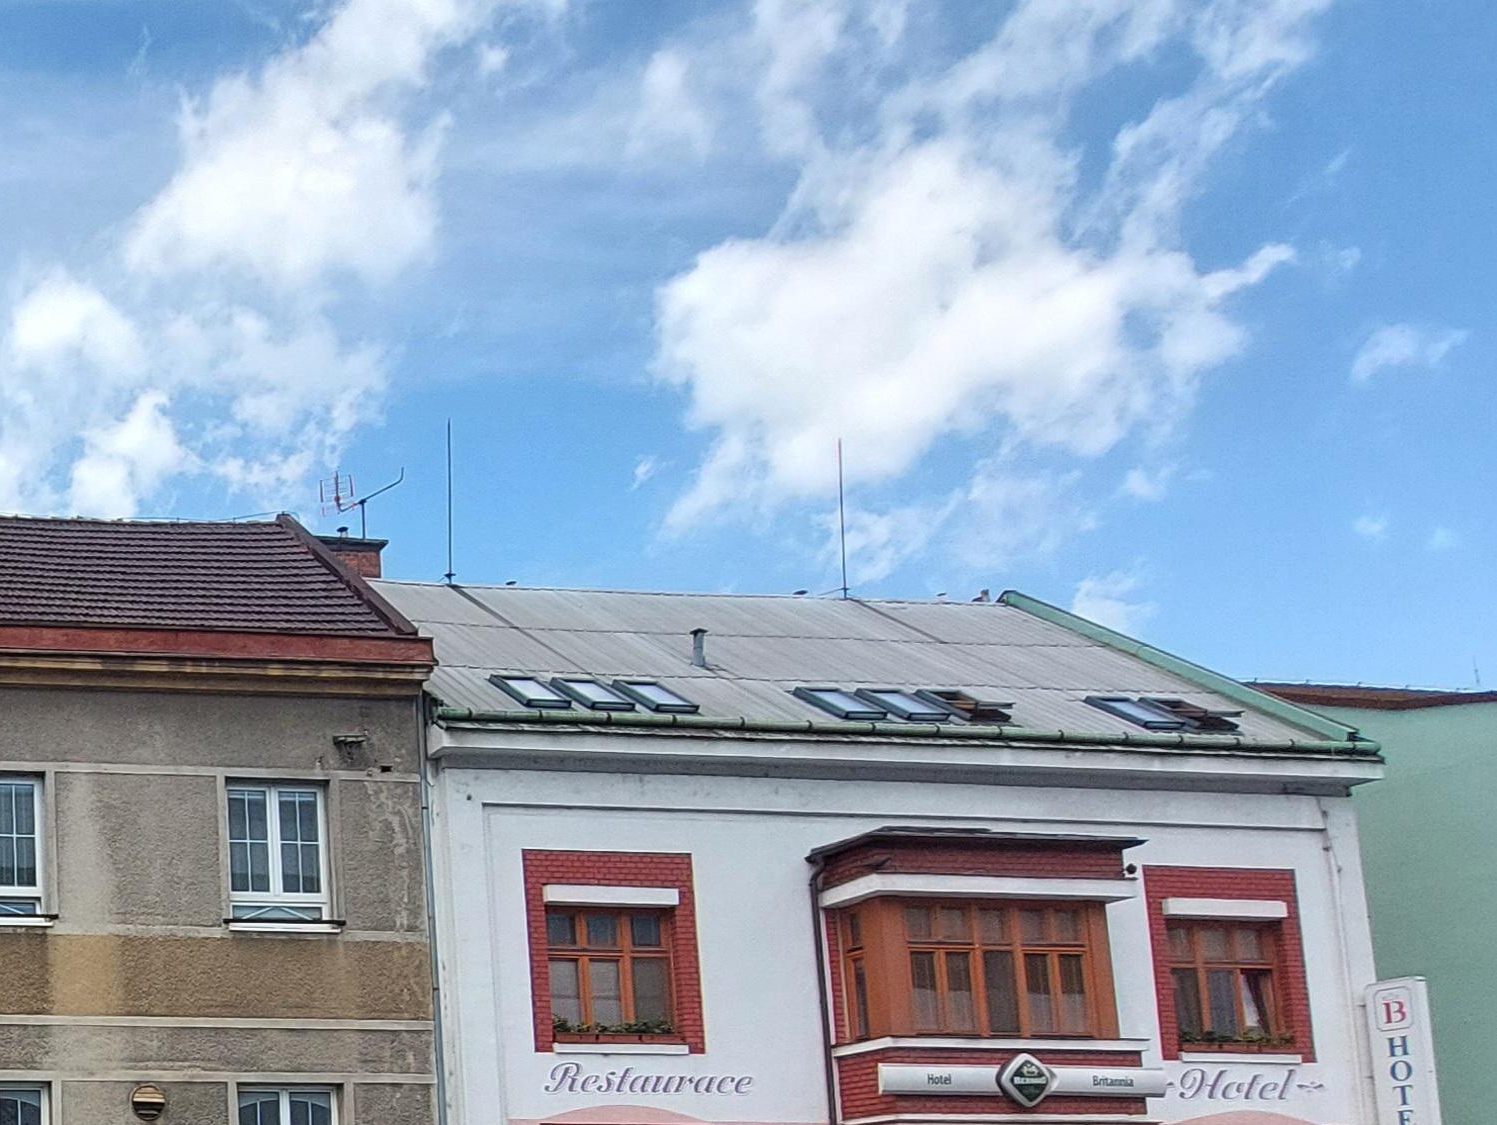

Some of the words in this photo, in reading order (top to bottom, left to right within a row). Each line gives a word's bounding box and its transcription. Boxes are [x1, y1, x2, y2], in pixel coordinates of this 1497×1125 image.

[1382, 1000, 1407, 1025] B
[544, 1061, 754, 1095] Restaurace
[927, 1073, 952, 1085] Hotel
[1092, 1075, 1134, 1087] Britannia
[1179, 1068, 1297, 1101] Hotel
